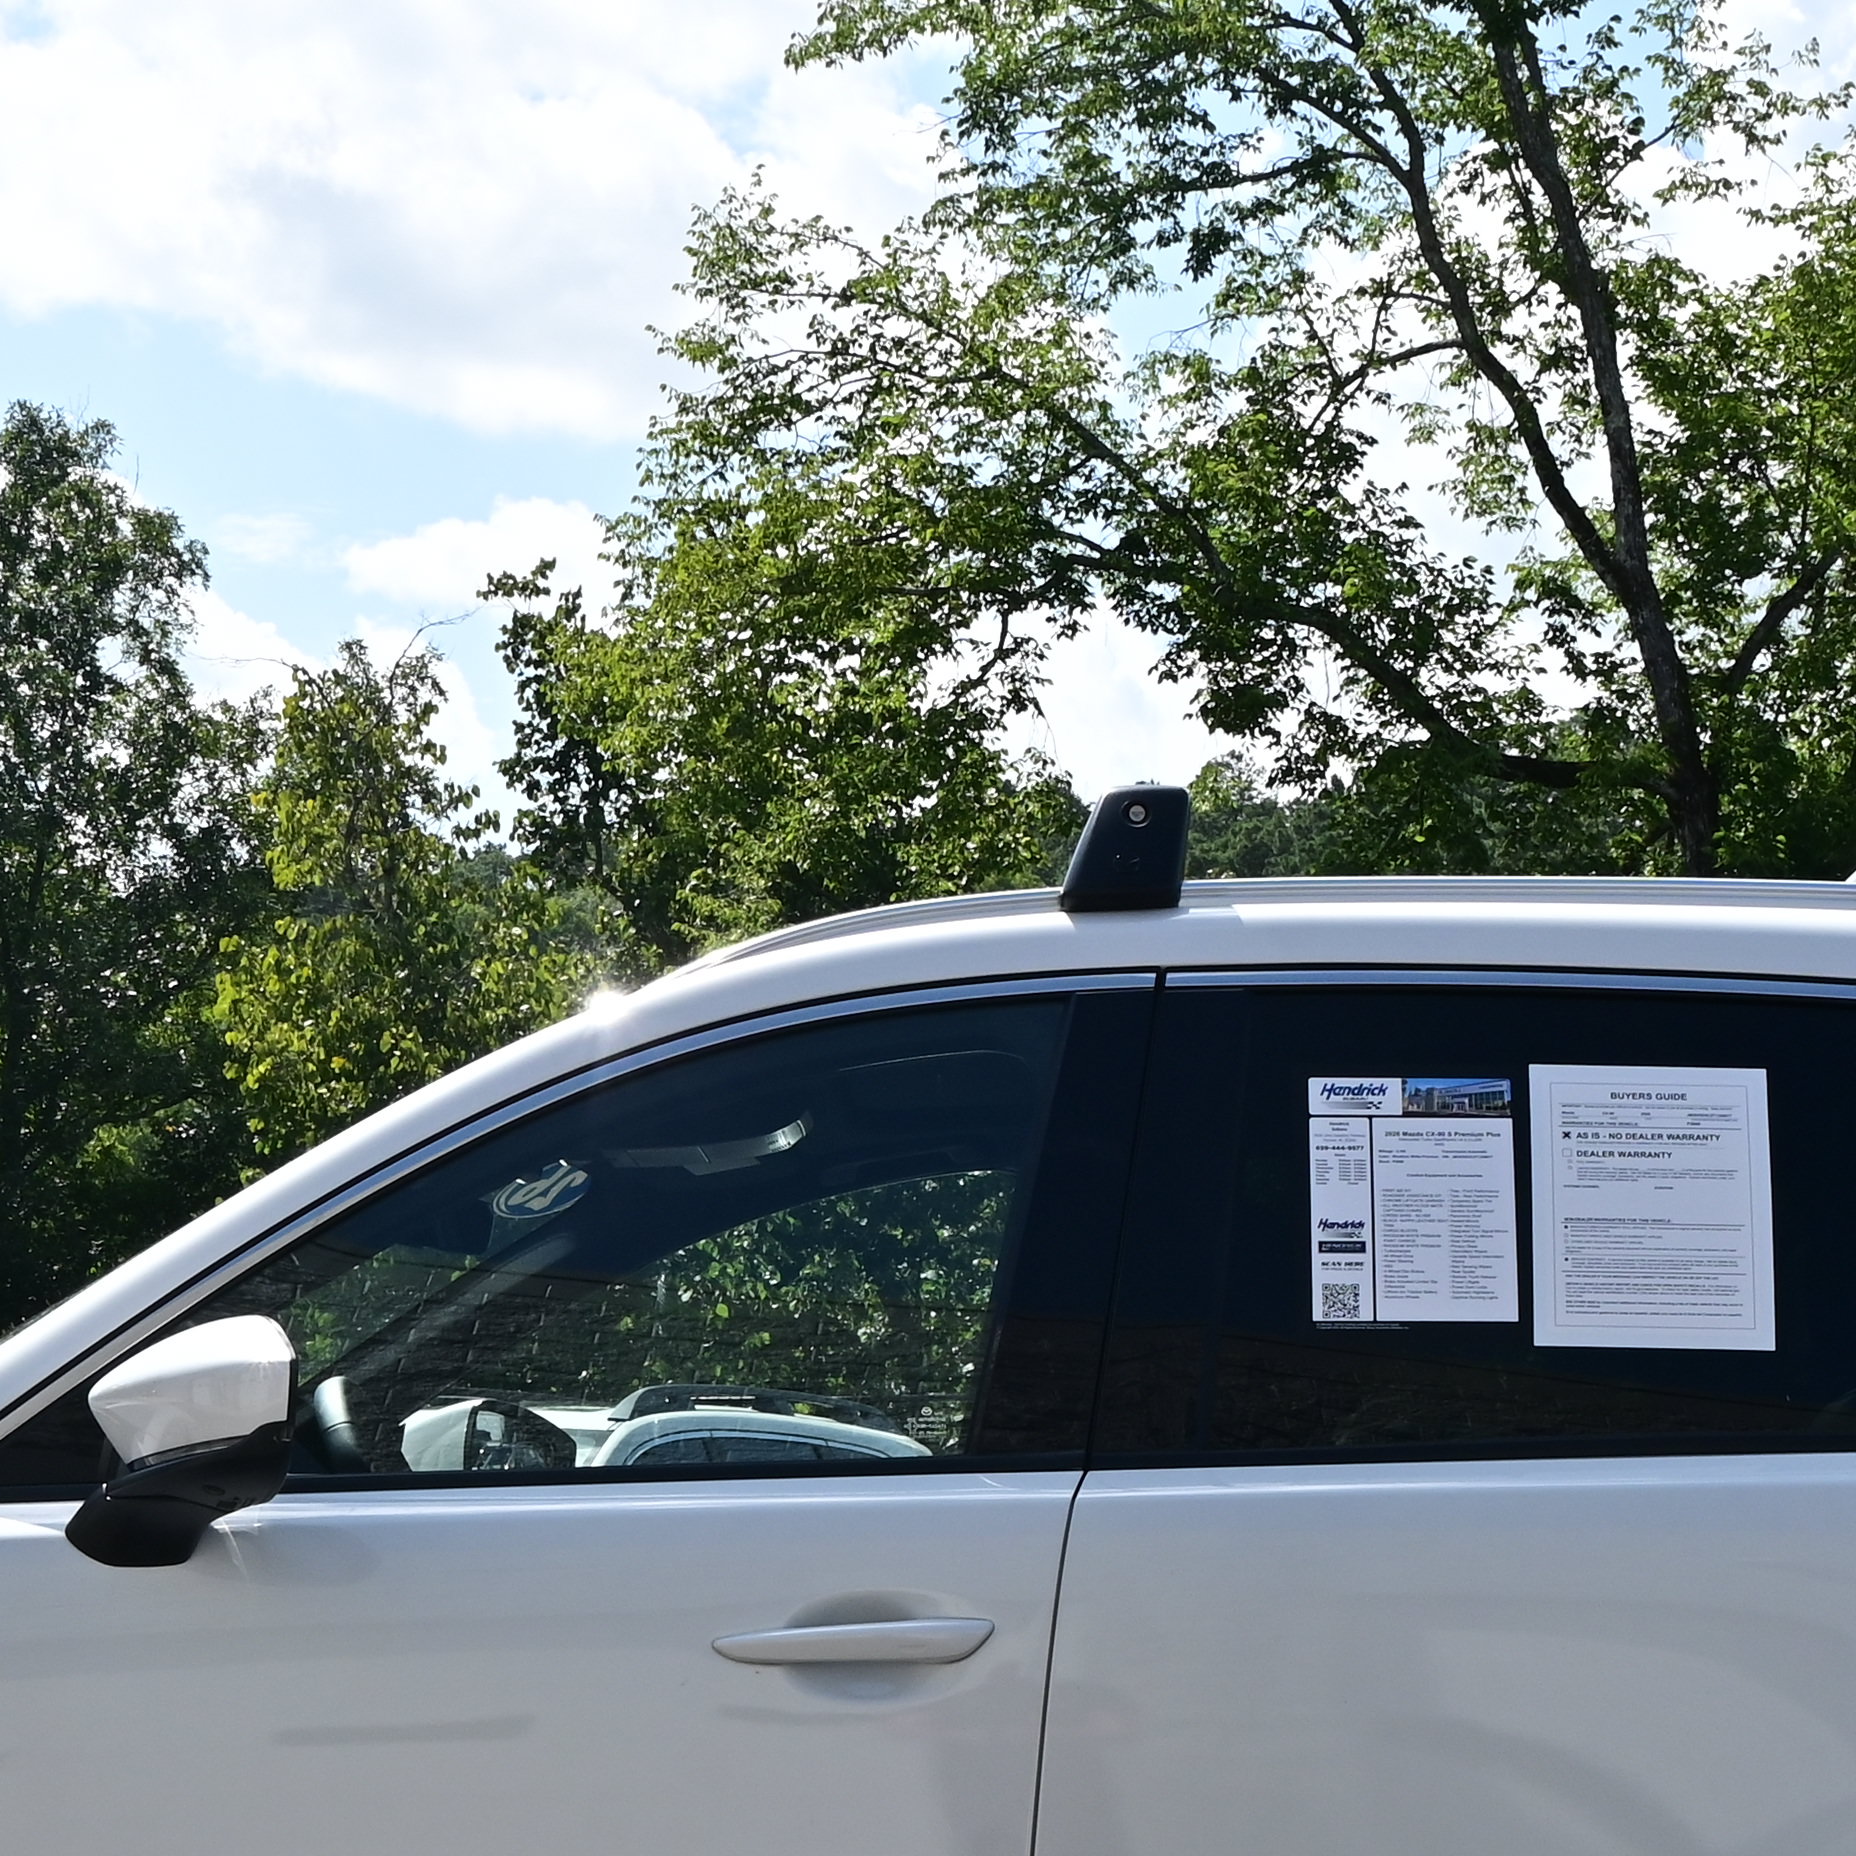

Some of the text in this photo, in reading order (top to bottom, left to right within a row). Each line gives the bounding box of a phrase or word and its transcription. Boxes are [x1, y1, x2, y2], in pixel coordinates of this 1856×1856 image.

[1320, 1083, 1388, 1100] Hendrick
[1610, 1091, 1688, 1101] BUYERS GUIDE
[1576, 1132, 1588, 1140] AS
[1591, 1132, 1601, 1140] IS
[1609, 1132, 1623, 1140] NO
[1626, 1133, 1664, 1141] DEALER
[1666, 1133, 1721, 1142] WARRANTY
[1576, 1150, 1673, 1159] DEALER WARRANTY
